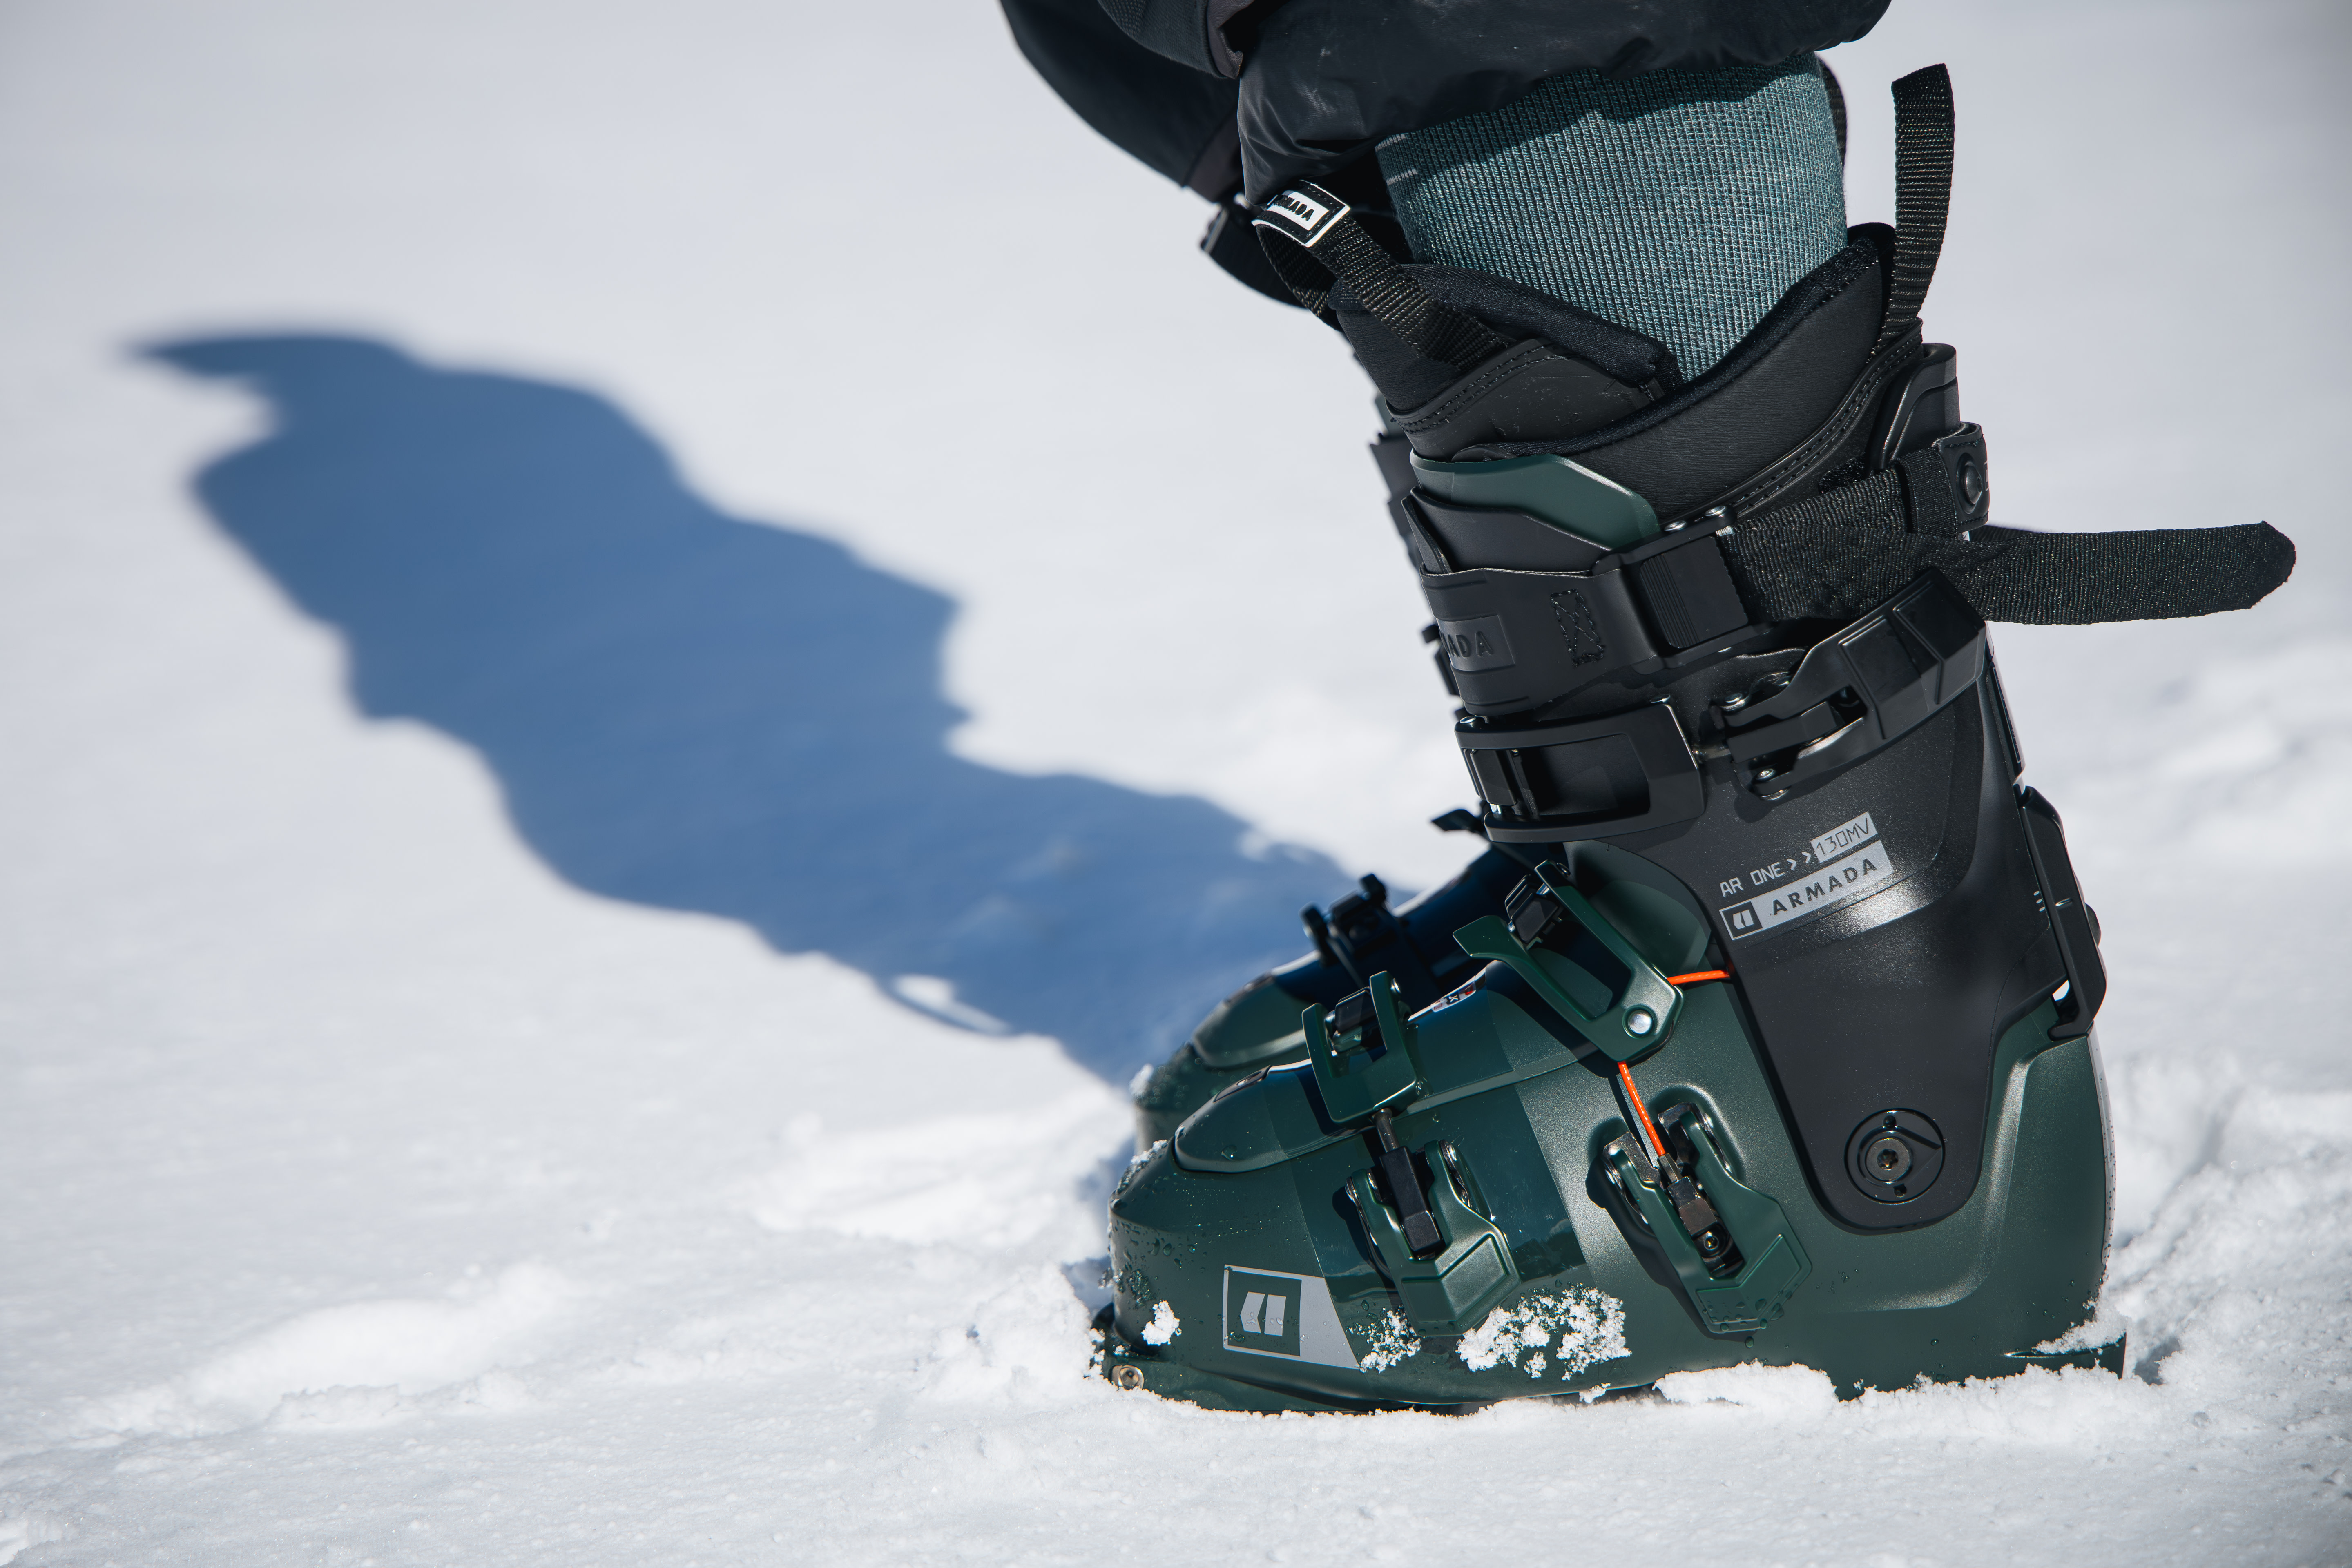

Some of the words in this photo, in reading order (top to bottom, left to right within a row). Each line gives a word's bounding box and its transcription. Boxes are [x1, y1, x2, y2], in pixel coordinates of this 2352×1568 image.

[1720, 877, 1744, 897] AR
[1749, 861, 1785, 886] ONE
[1816, 817, 1869, 856] 130MV
[1773, 858, 1877, 916] ARMADA
